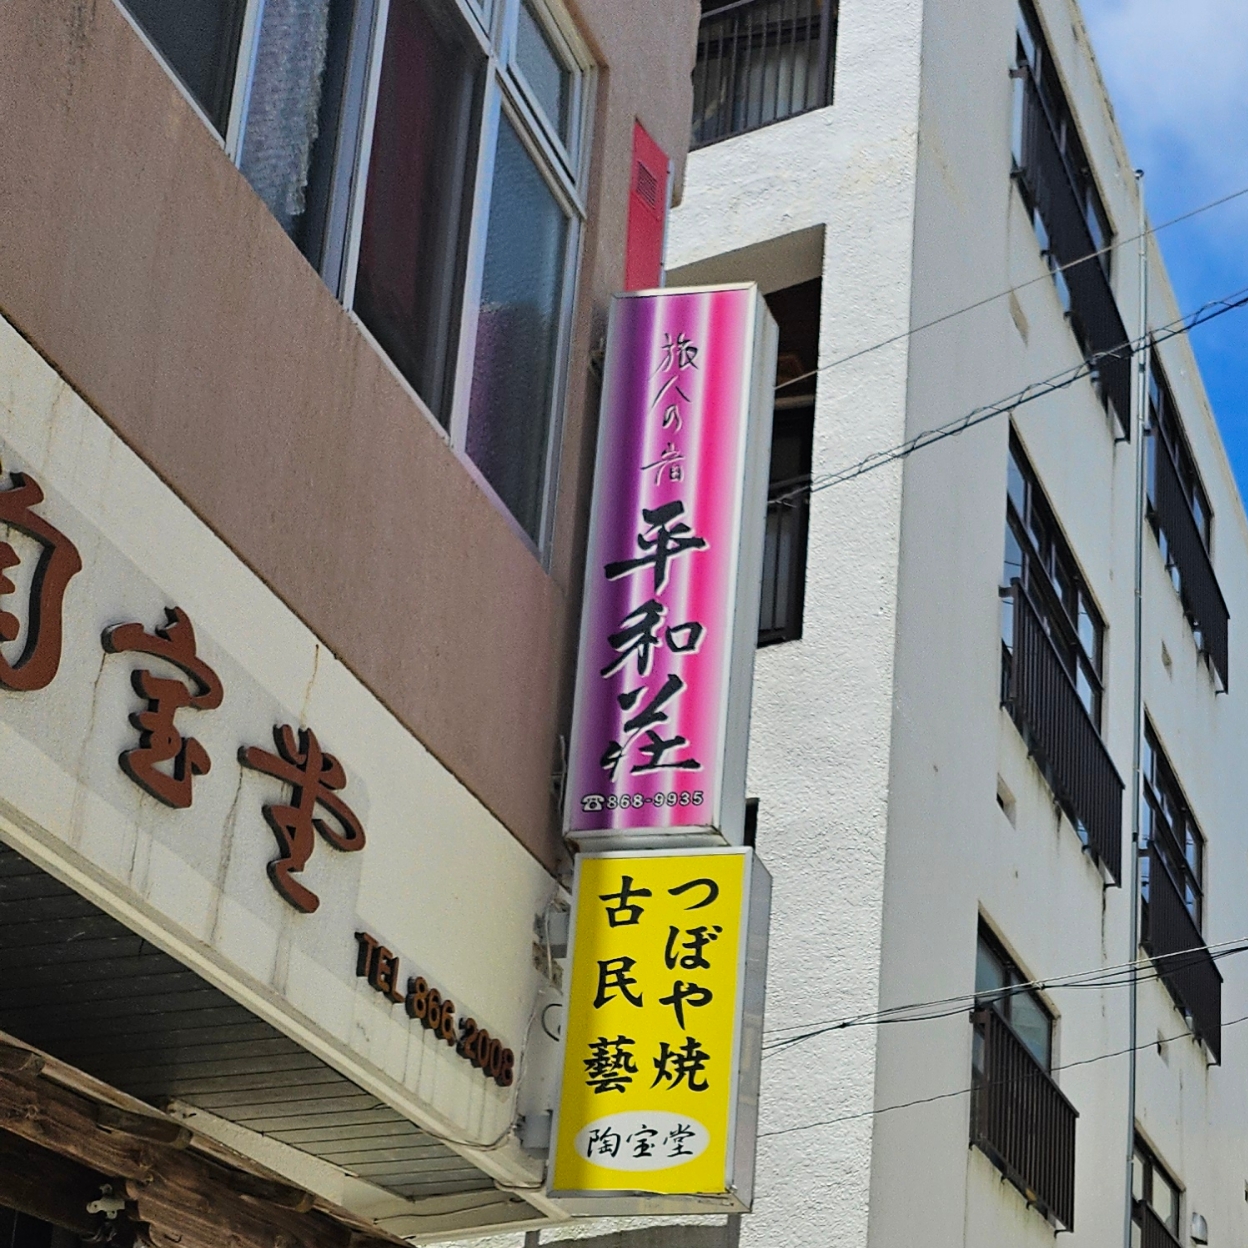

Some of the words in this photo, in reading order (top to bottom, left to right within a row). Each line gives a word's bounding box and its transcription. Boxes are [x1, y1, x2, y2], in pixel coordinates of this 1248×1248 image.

[603, 500, 708, 784] 平和荘
[606, 789, 704, 811] 868-9935
[583, 875, 653, 1094] 古民藝
[649, 877, 723, 1092] つぼや焼
[587, 1122, 697, 1158] 陶宝堂
